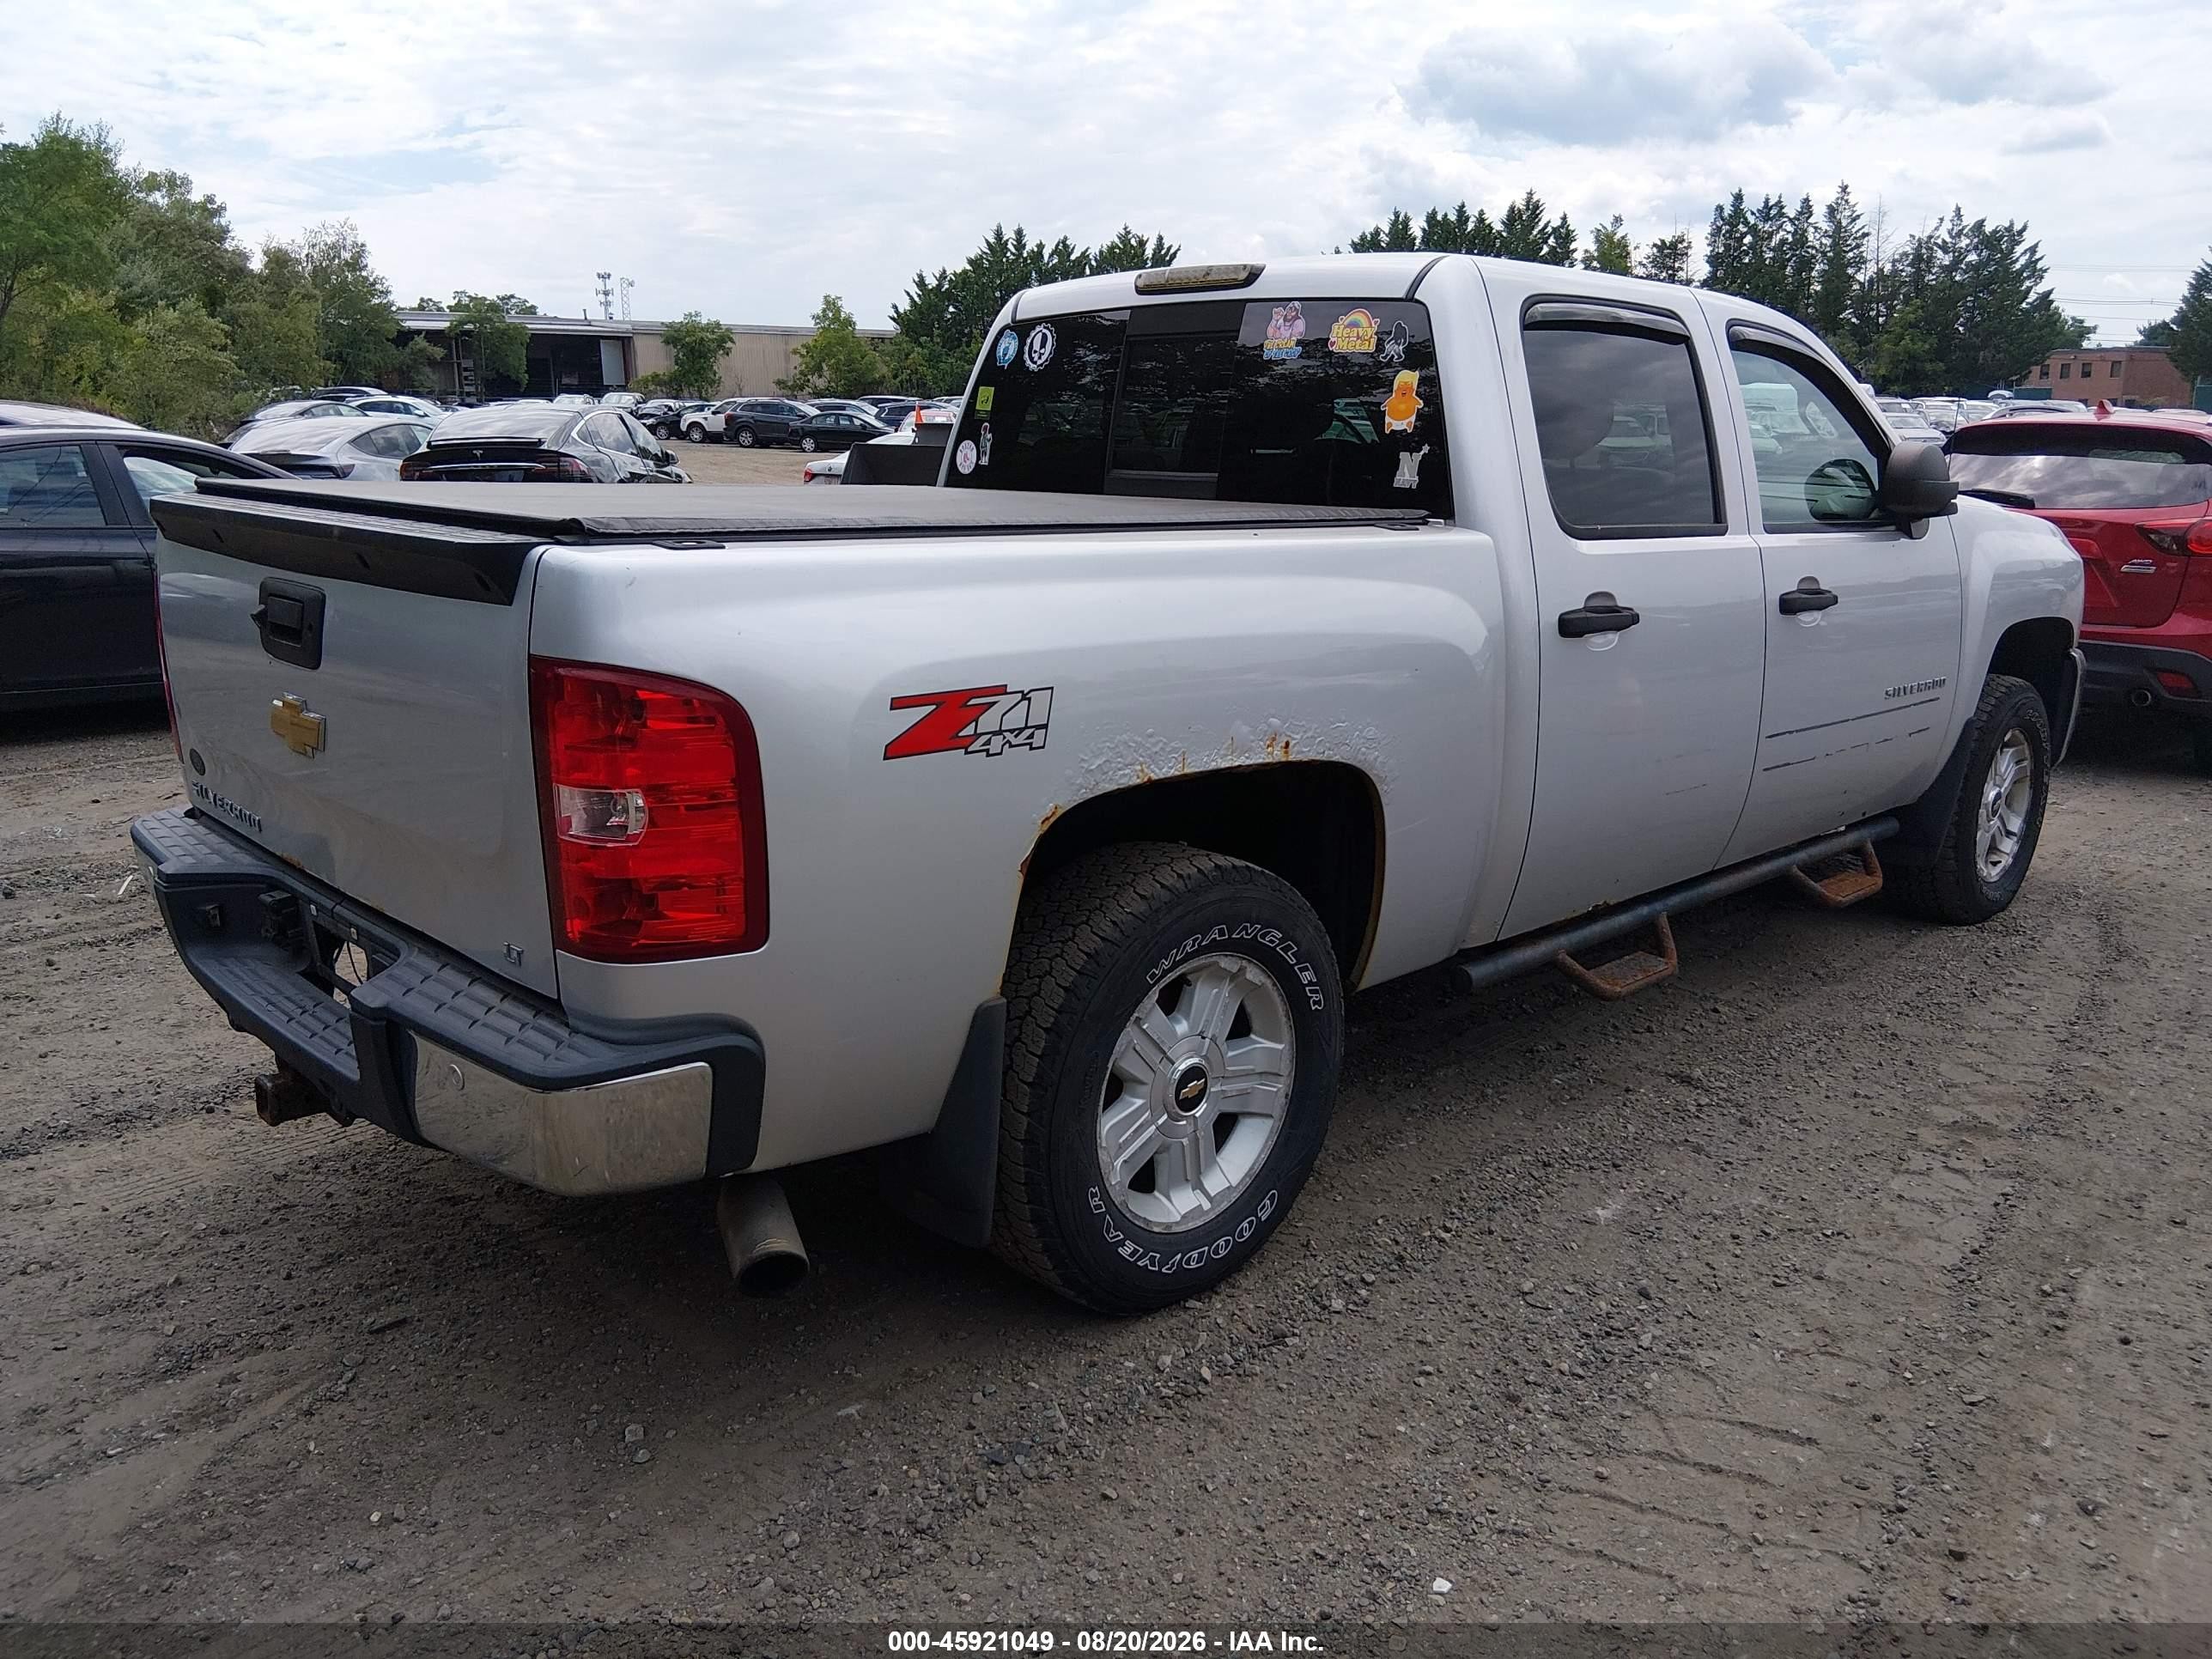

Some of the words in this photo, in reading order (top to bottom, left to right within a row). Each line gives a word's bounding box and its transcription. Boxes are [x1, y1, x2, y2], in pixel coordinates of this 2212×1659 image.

[1332, 325, 1374, 340] Heavy
[1335, 337, 1375, 349] Metal
[1884, 676, 1948, 700] SILVERADO
[883, 684, 1054, 761] Z71
[1146, 923, 1324, 1011] WRANGLER
[1087, 1185, 1279, 1273] GOODYEAR
